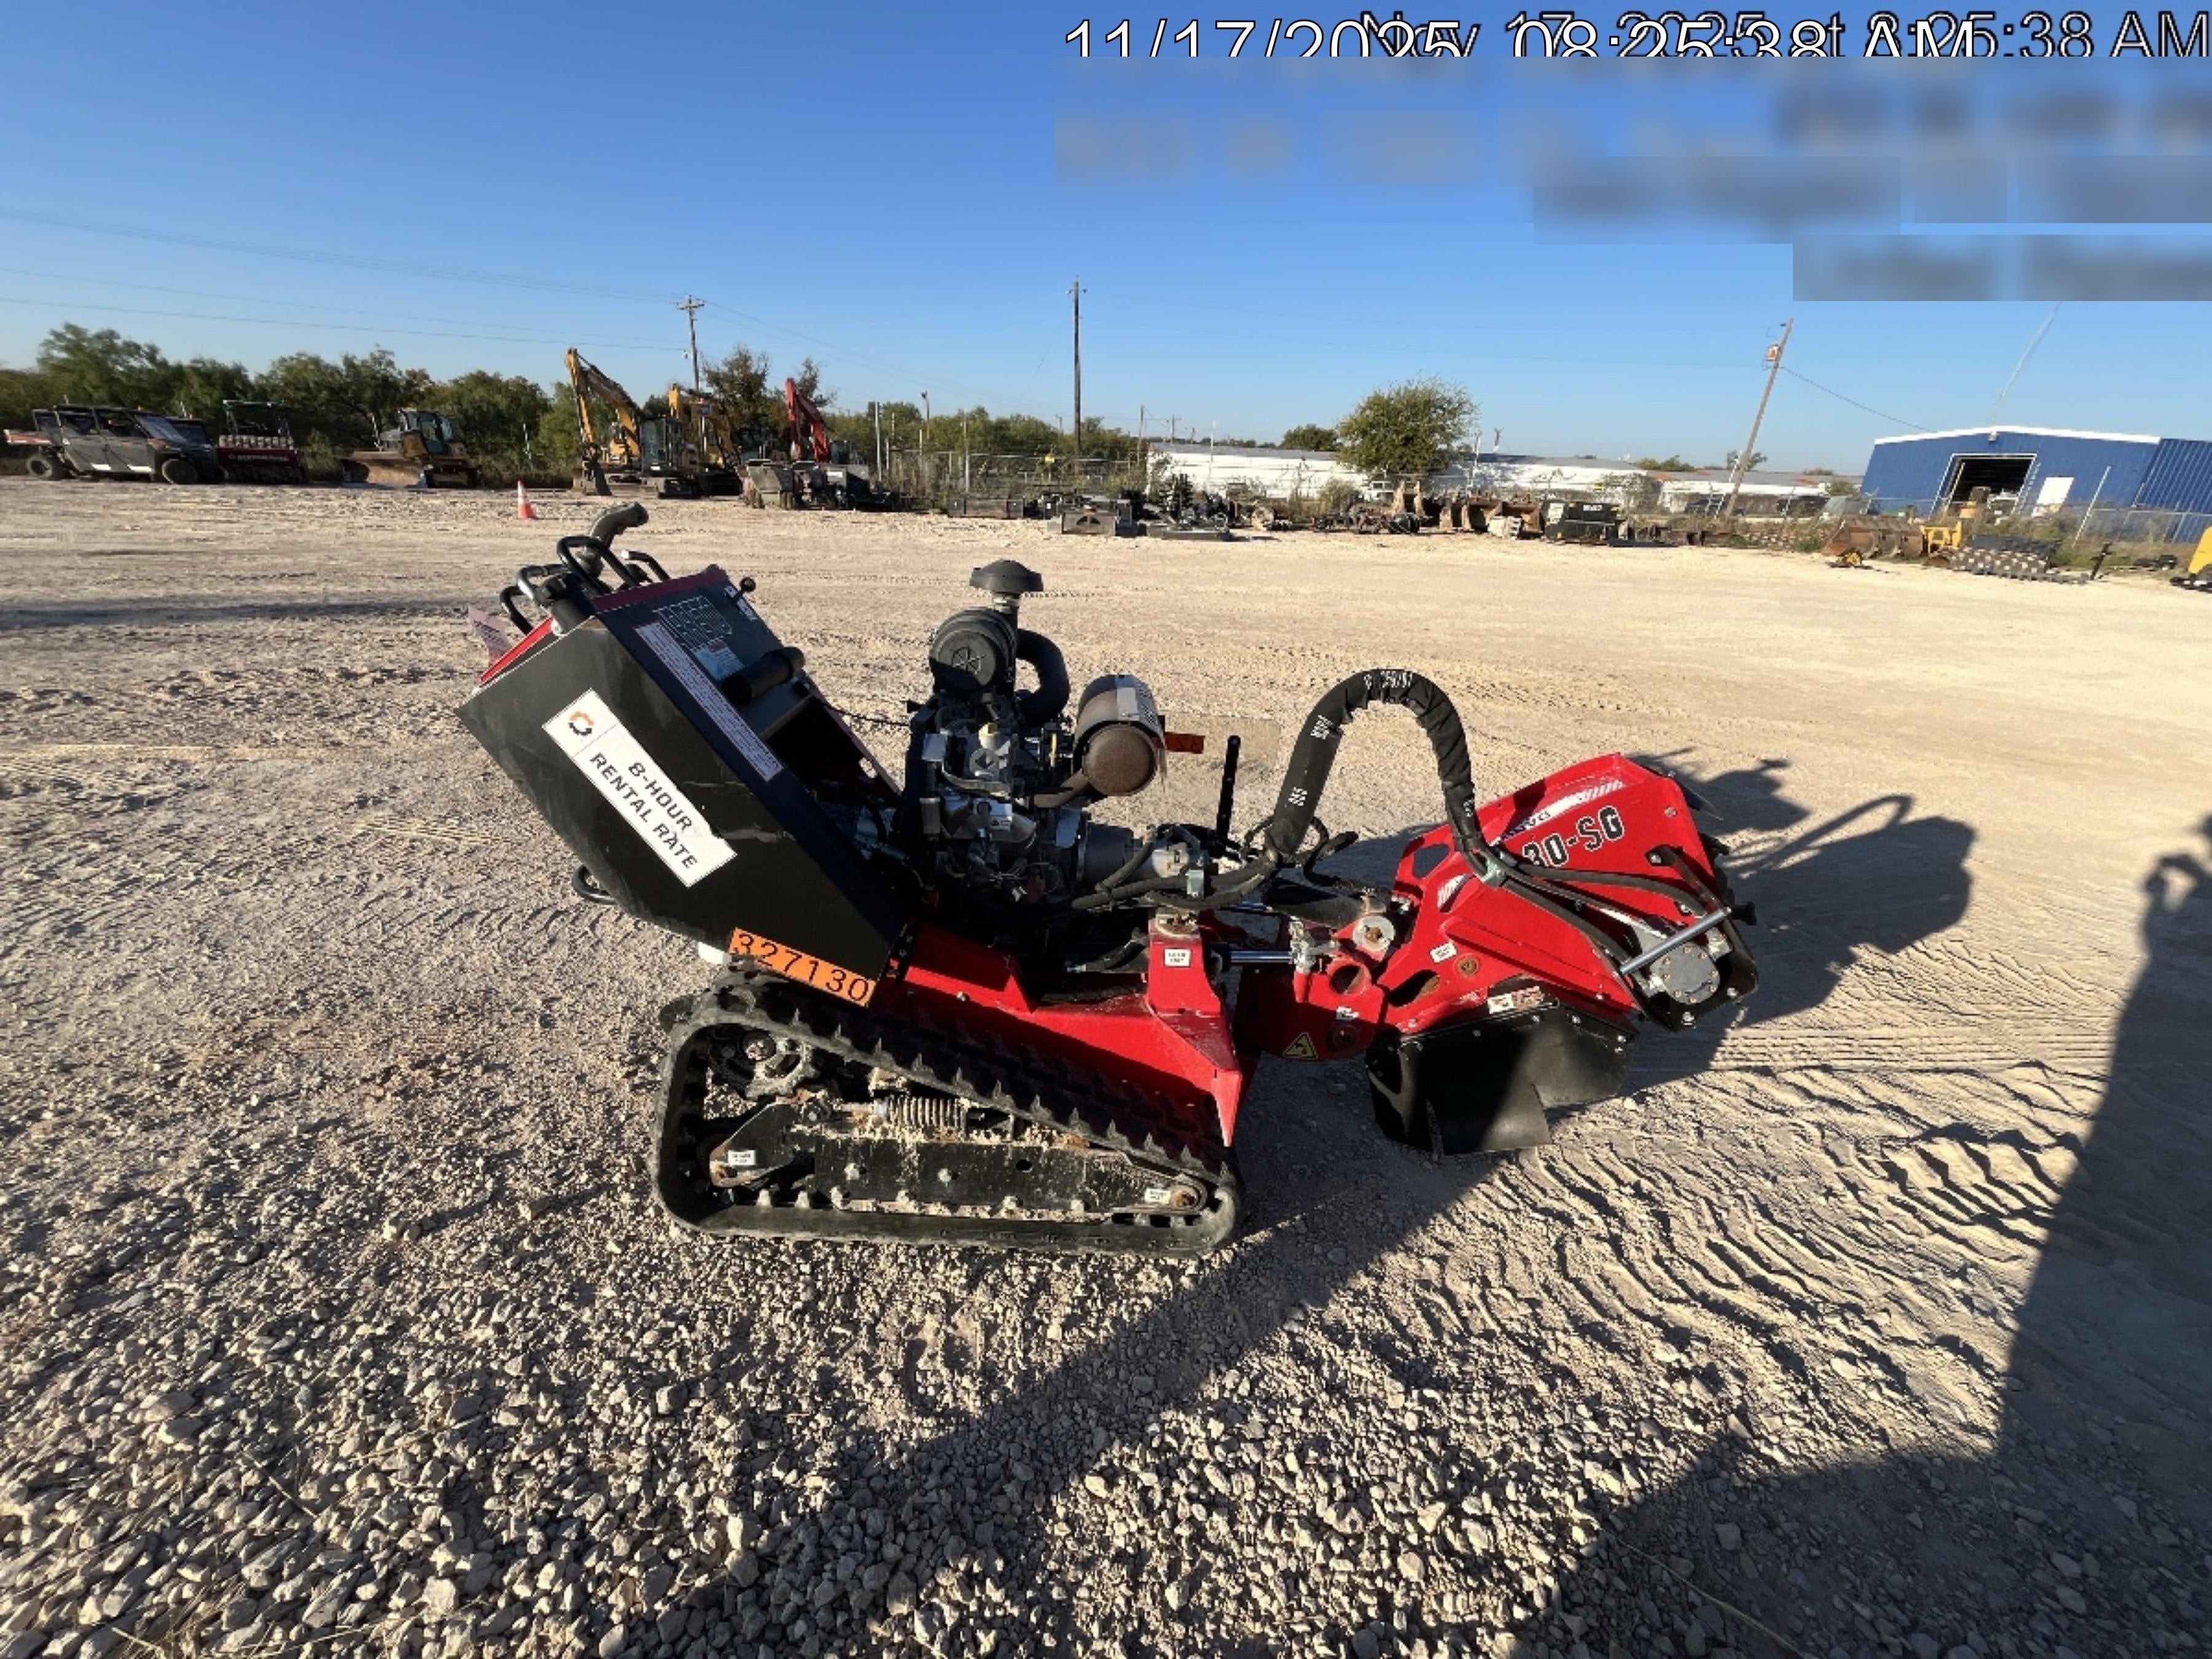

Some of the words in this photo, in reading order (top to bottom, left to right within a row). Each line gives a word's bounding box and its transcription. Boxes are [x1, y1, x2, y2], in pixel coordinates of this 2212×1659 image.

[590, 751, 653, 822] RENTAL
[653, 823, 698, 869] RATE
[627, 762, 692, 830] 8-HOUR
[734, 933, 869, 1001] 327130
